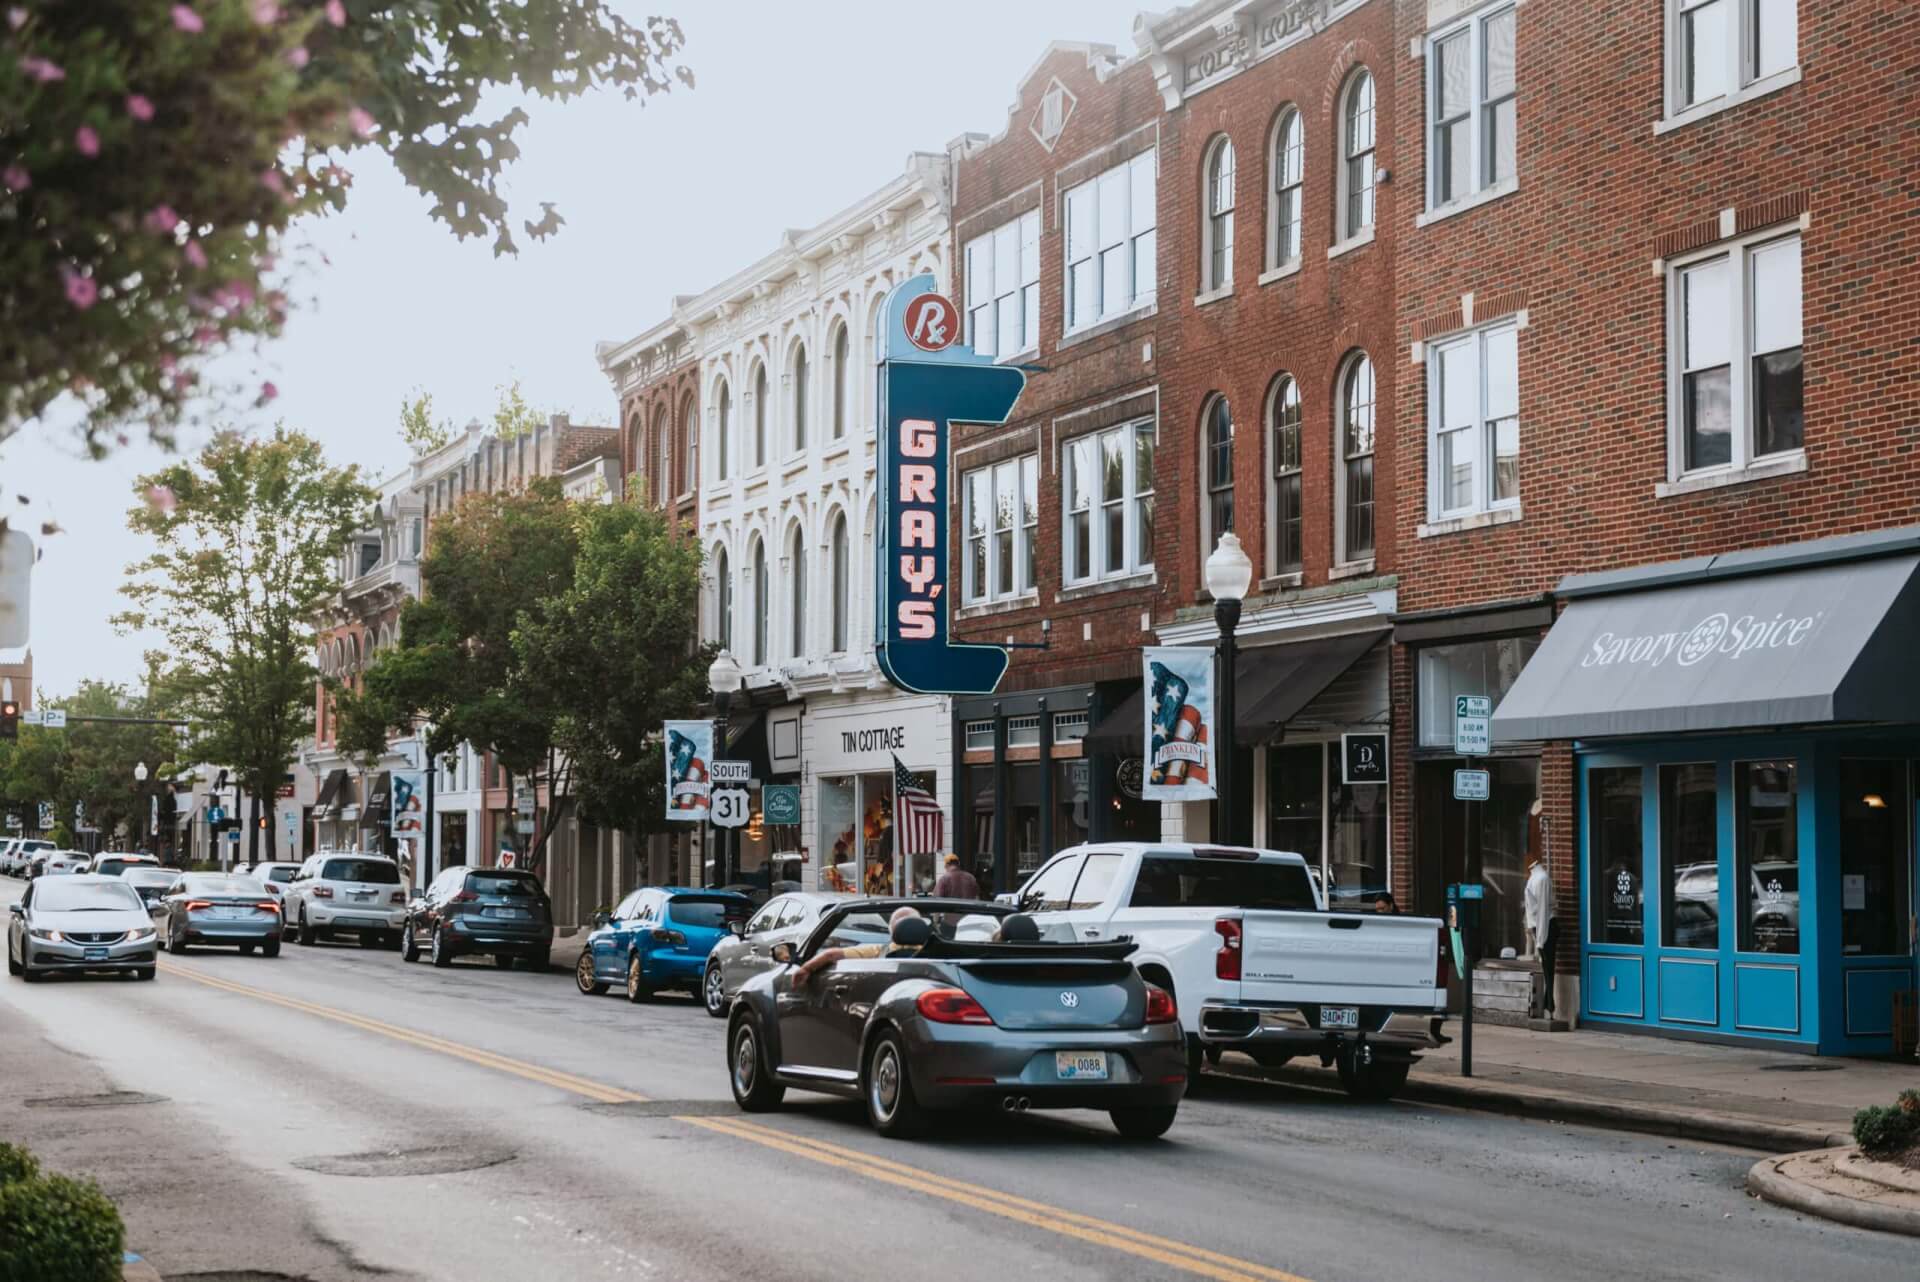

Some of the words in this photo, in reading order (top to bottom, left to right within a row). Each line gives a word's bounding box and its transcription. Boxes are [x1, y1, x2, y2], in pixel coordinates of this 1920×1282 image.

[898, 418, 943, 639] GRAY'S
[1581, 631, 1690, 668] Savory
[1720, 612, 1814, 660] Spice
[1458, 700, 1467, 716] 2
[841, 731, 857, 753] TIN
[858, 726, 905, 752] COTTAGE
[712, 764, 749, 777] SOUTH
[717, 795, 741, 818] 31
[1078, 1058, 1101, 1072] 0088
